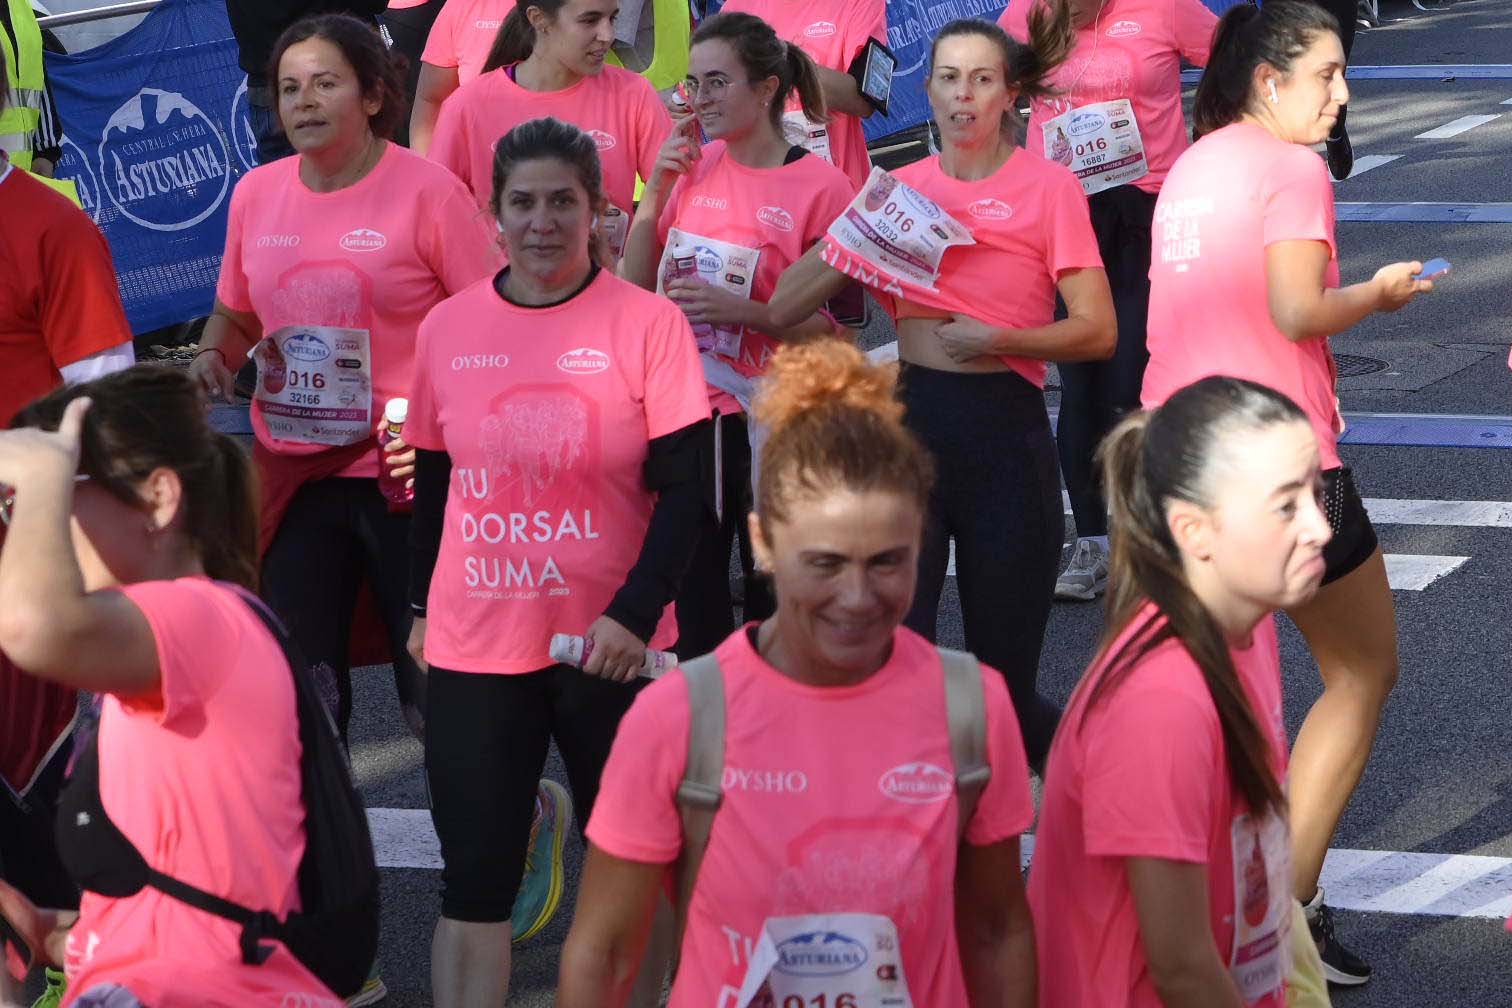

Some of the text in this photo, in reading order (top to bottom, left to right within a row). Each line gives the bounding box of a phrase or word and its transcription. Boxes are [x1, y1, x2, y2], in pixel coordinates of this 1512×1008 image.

[1075, 138, 1107, 156] 016
[1081, 154, 1106, 166] 16887
[112, 144, 224, 203] ASTURIANA
[875, 219, 898, 243] 32032
[884, 201, 914, 234] 016
[452, 354, 510, 370] OYSHO
[289, 370, 325, 389] 016
[458, 468, 489, 500] TU
[461, 509, 600, 544] DORSAL
[464, 556, 566, 588] SUMA
